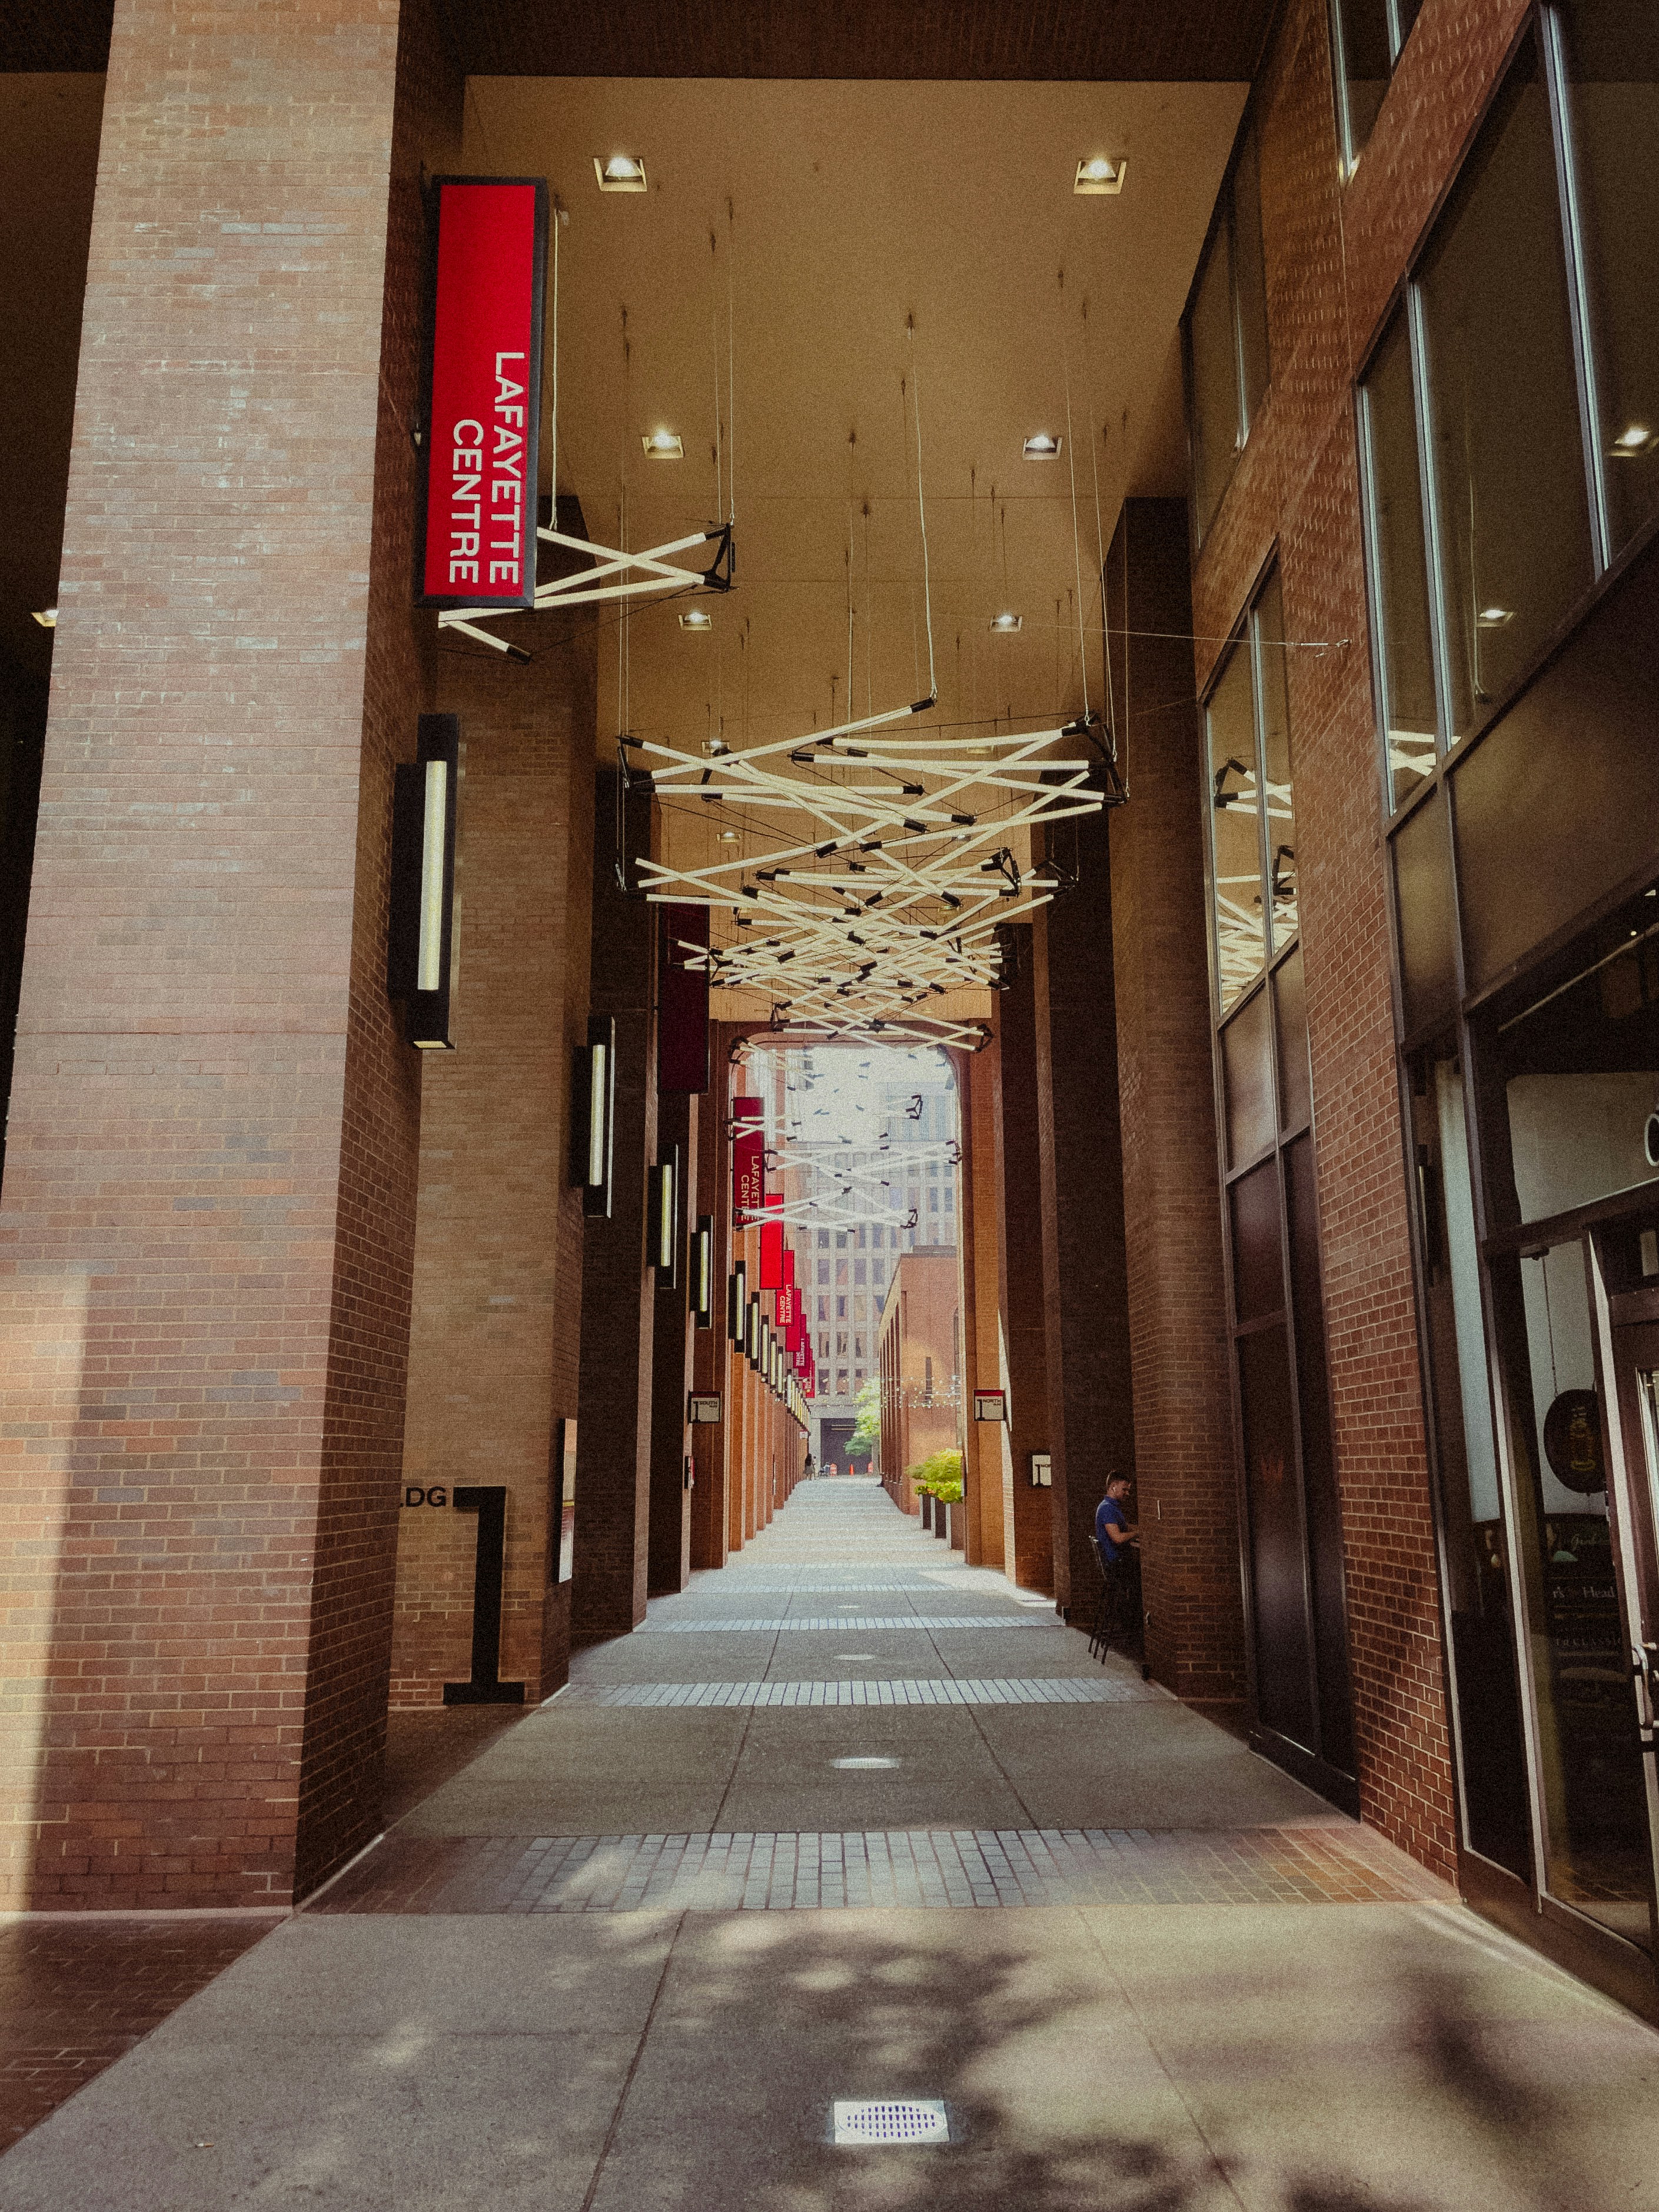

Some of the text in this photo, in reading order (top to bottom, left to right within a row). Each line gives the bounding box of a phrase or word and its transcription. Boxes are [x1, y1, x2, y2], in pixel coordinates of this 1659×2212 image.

[448, 419, 484, 583] CENTRE
[490, 352, 524, 583] LAFAYETTE
[751, 1155, 760, 1221] LAFAYETE
[400, 1486, 525, 1705] DG 1
[1582, 1586, 1615, 1599] Head
